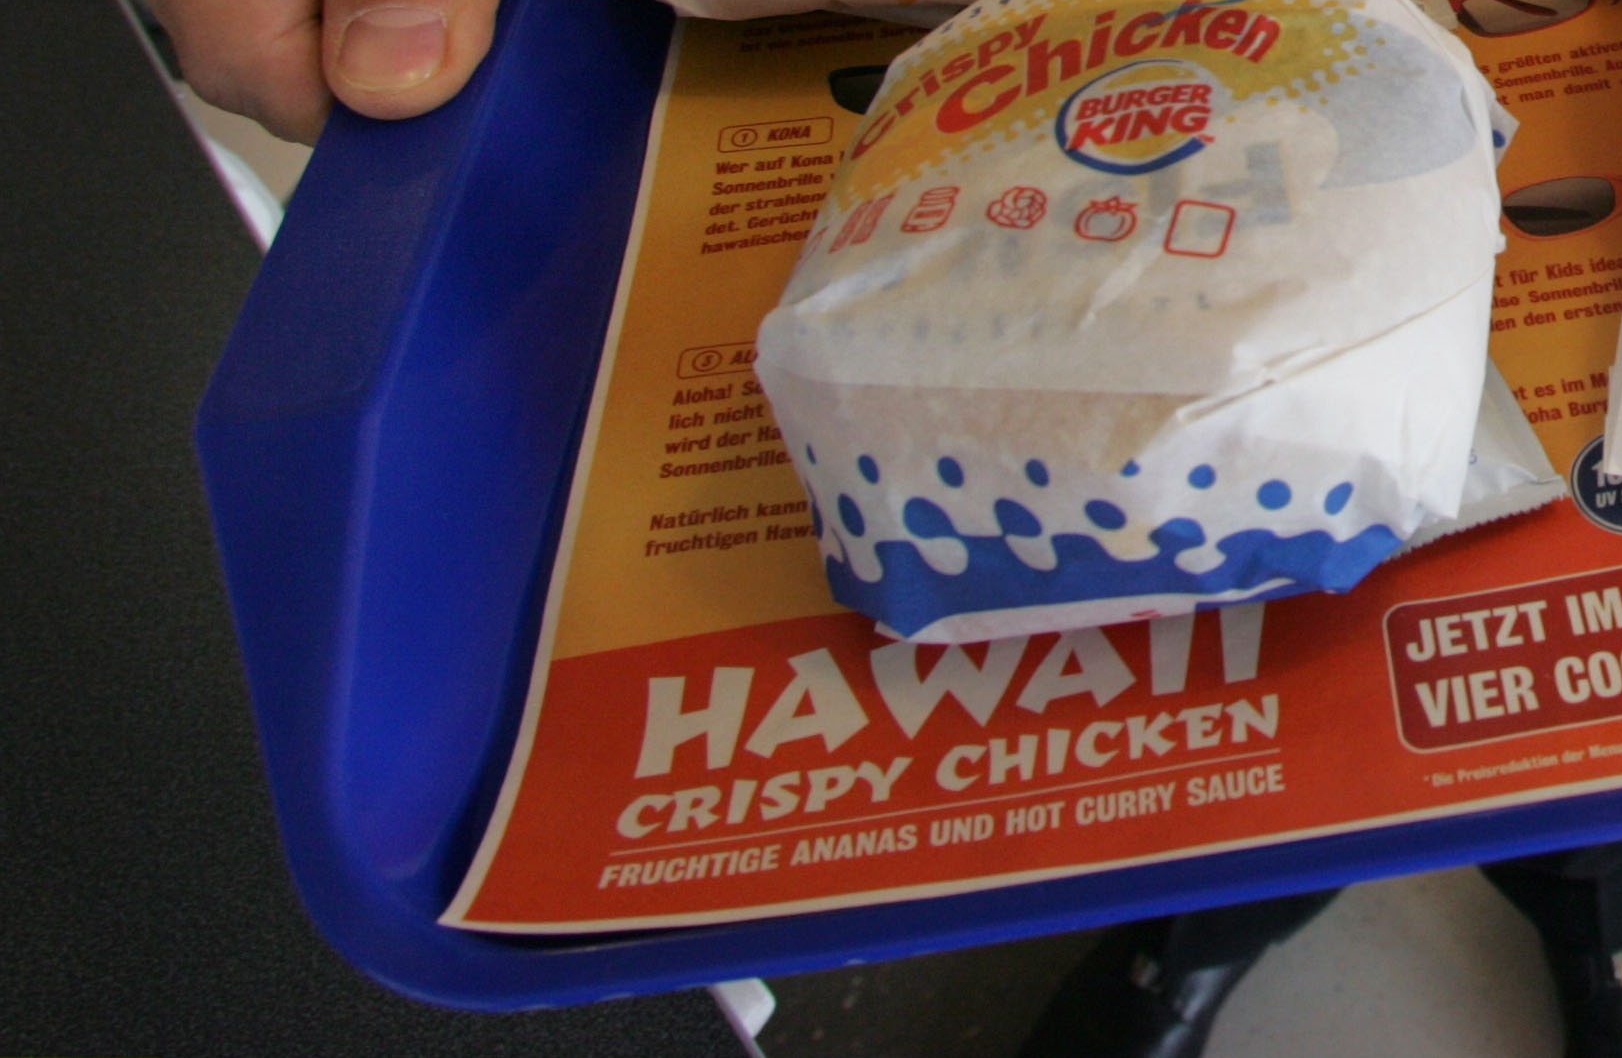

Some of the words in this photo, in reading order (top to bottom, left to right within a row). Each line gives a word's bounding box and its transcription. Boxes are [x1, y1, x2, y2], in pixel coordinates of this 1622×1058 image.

[1497, 50, 1563, 74] größten
[850, 13, 1048, 160] Crispy
[1493, 65, 1599, 90] Sonnenbrille.
[1074, 82, 1214, 123] BURGER
[1518, 88, 1556, 103] man
[1563, 78, 1612, 96] damit
[767, 124, 812, 143] KONA
[1066, 105, 1213, 151] KING
[716, 159, 749, 175] Wer
[754, 156, 785, 171] auf
[789, 153, 834, 170] Kona
[711, 172, 824, 196] Sonnenbrille
[708, 202, 741, 217] der
[704, 218, 741, 236] det.
[1509, 267, 1538, 287] für
[1545, 260, 1584, 280] Kids
[1491, 293, 1520, 310] lso
[1523, 309, 1557, 327] den
[672, 383, 733, 407] Aloha!
[1534, 383, 1558, 399] es
[1561, 377, 1585, 393] im
[668, 414, 705, 431] lich
[713, 404, 764, 426] nicht
[1524, 405, 1563, 424] oha
[664, 434, 711, 455] wird
[716, 431, 753, 449] der
[659, 450, 793, 480] Sonnenbrille.
[1595, 491, 1617, 509] UV
[649, 504, 749, 532] Natürlich
[755, 499, 809, 519] kann
[644, 529, 758, 558] fruchtigen
[1406, 600, 1547, 662] JETZT
[1414, 665, 1539, 729] VIER
[615, 756, 914, 839] CRISPY
[935, 693, 1280, 792] CHICKEN
[1562, 747, 1586, 764] der
[598, 844, 782, 889] FRUCHTIGE
[789, 823, 918, 867] ANANAS
[929, 813, 994, 846] UND
[1005, 800, 1066, 836] HOT
[1075, 782, 1176, 826] CURRY
[1187, 763, 1286, 807] SAUCE
